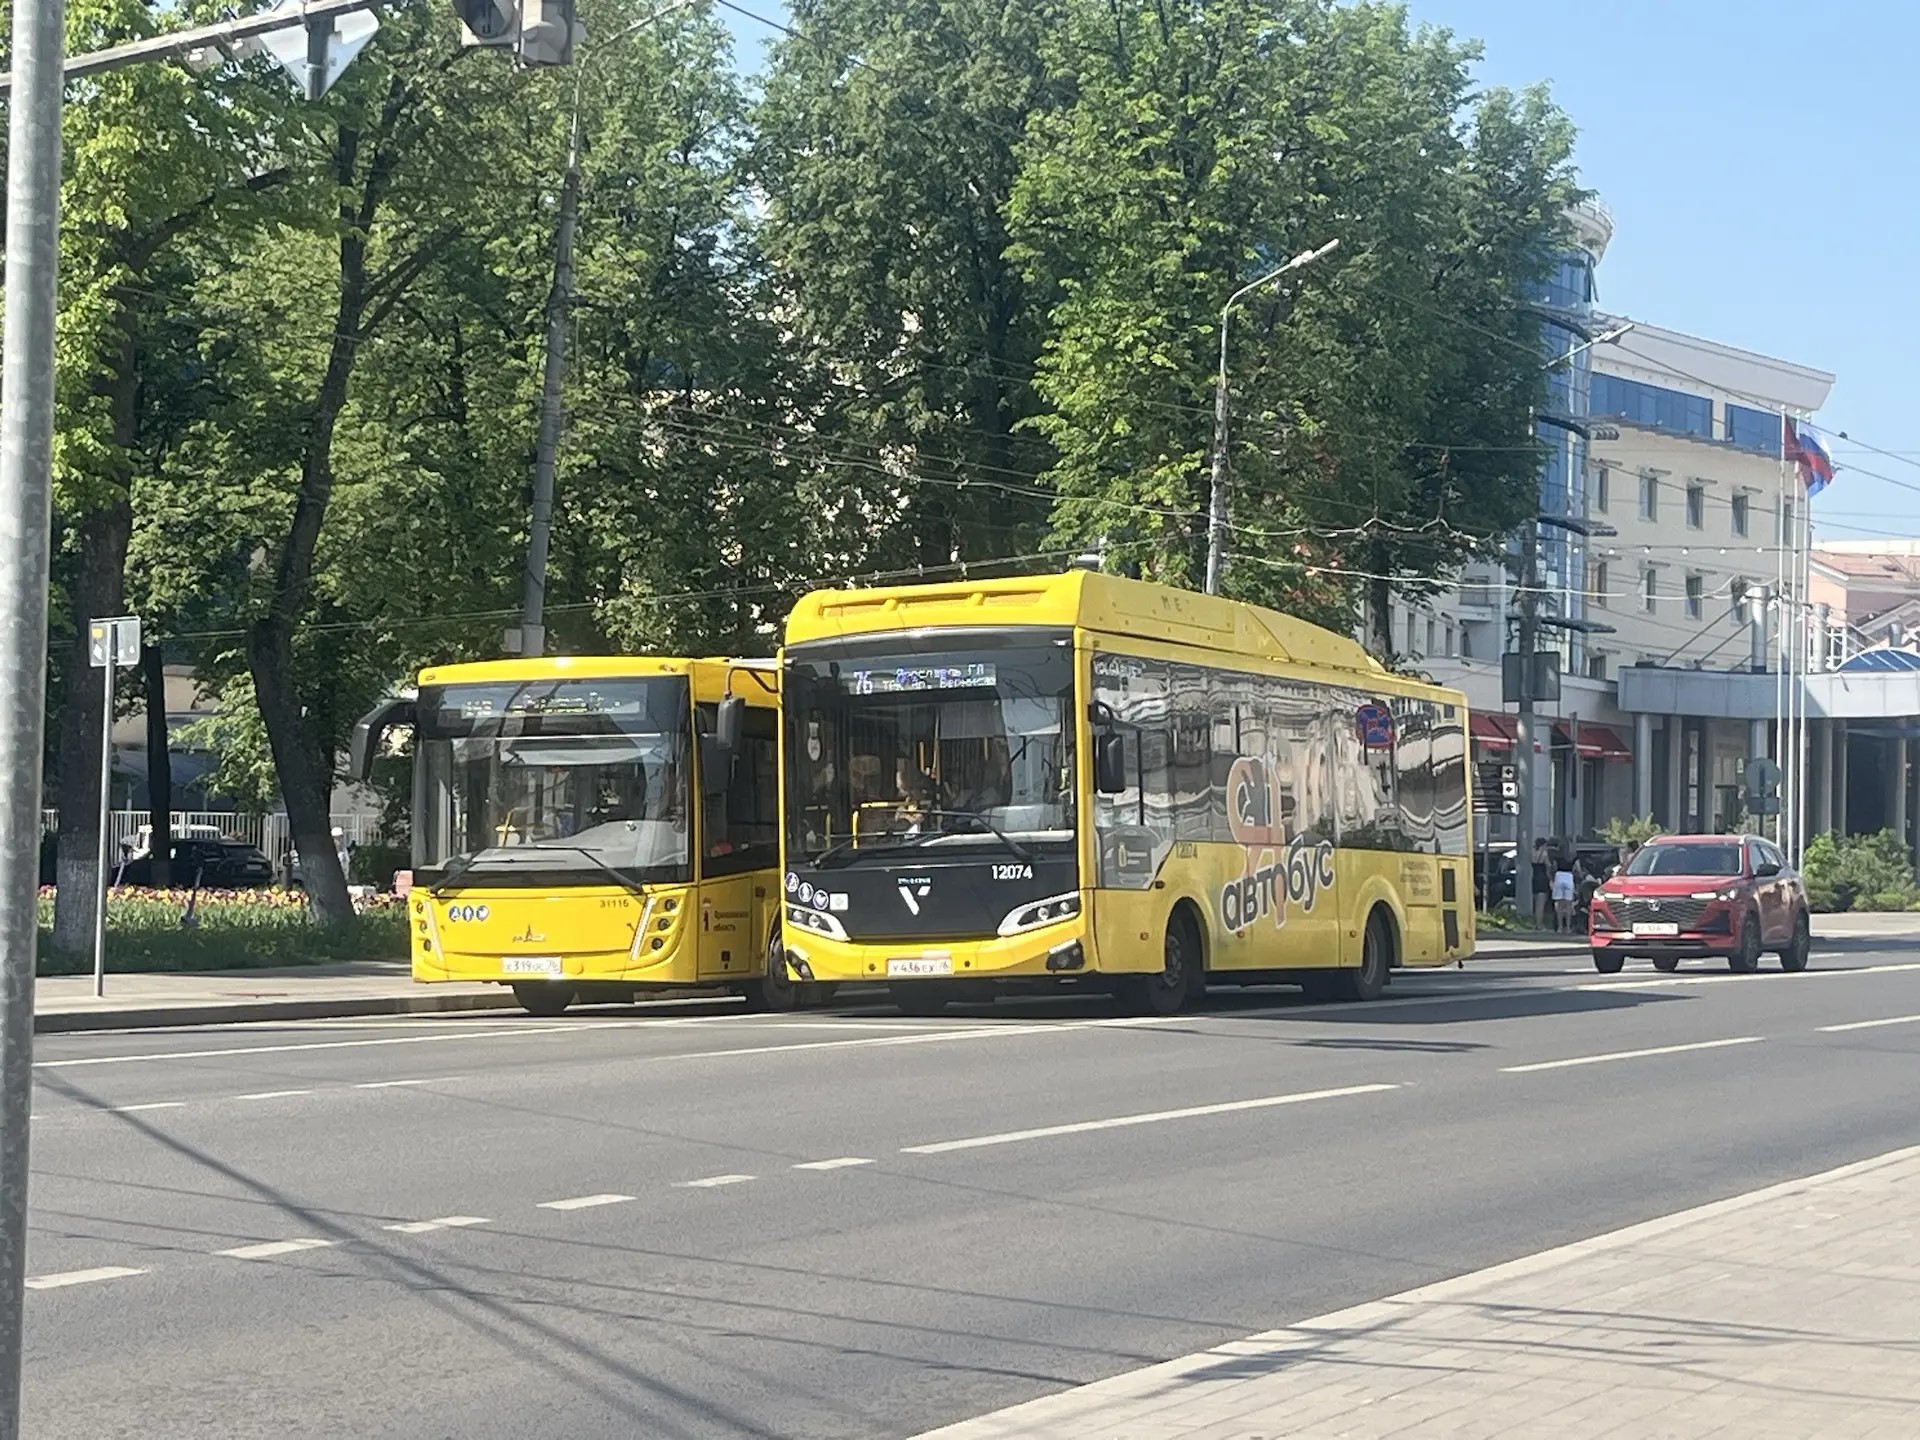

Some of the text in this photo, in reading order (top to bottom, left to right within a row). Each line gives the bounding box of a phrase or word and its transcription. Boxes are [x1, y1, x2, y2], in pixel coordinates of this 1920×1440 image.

[853, 671, 873, 695] 76
[991, 864, 1033, 880] 12074
[1222, 836, 1334, 932] автобус
